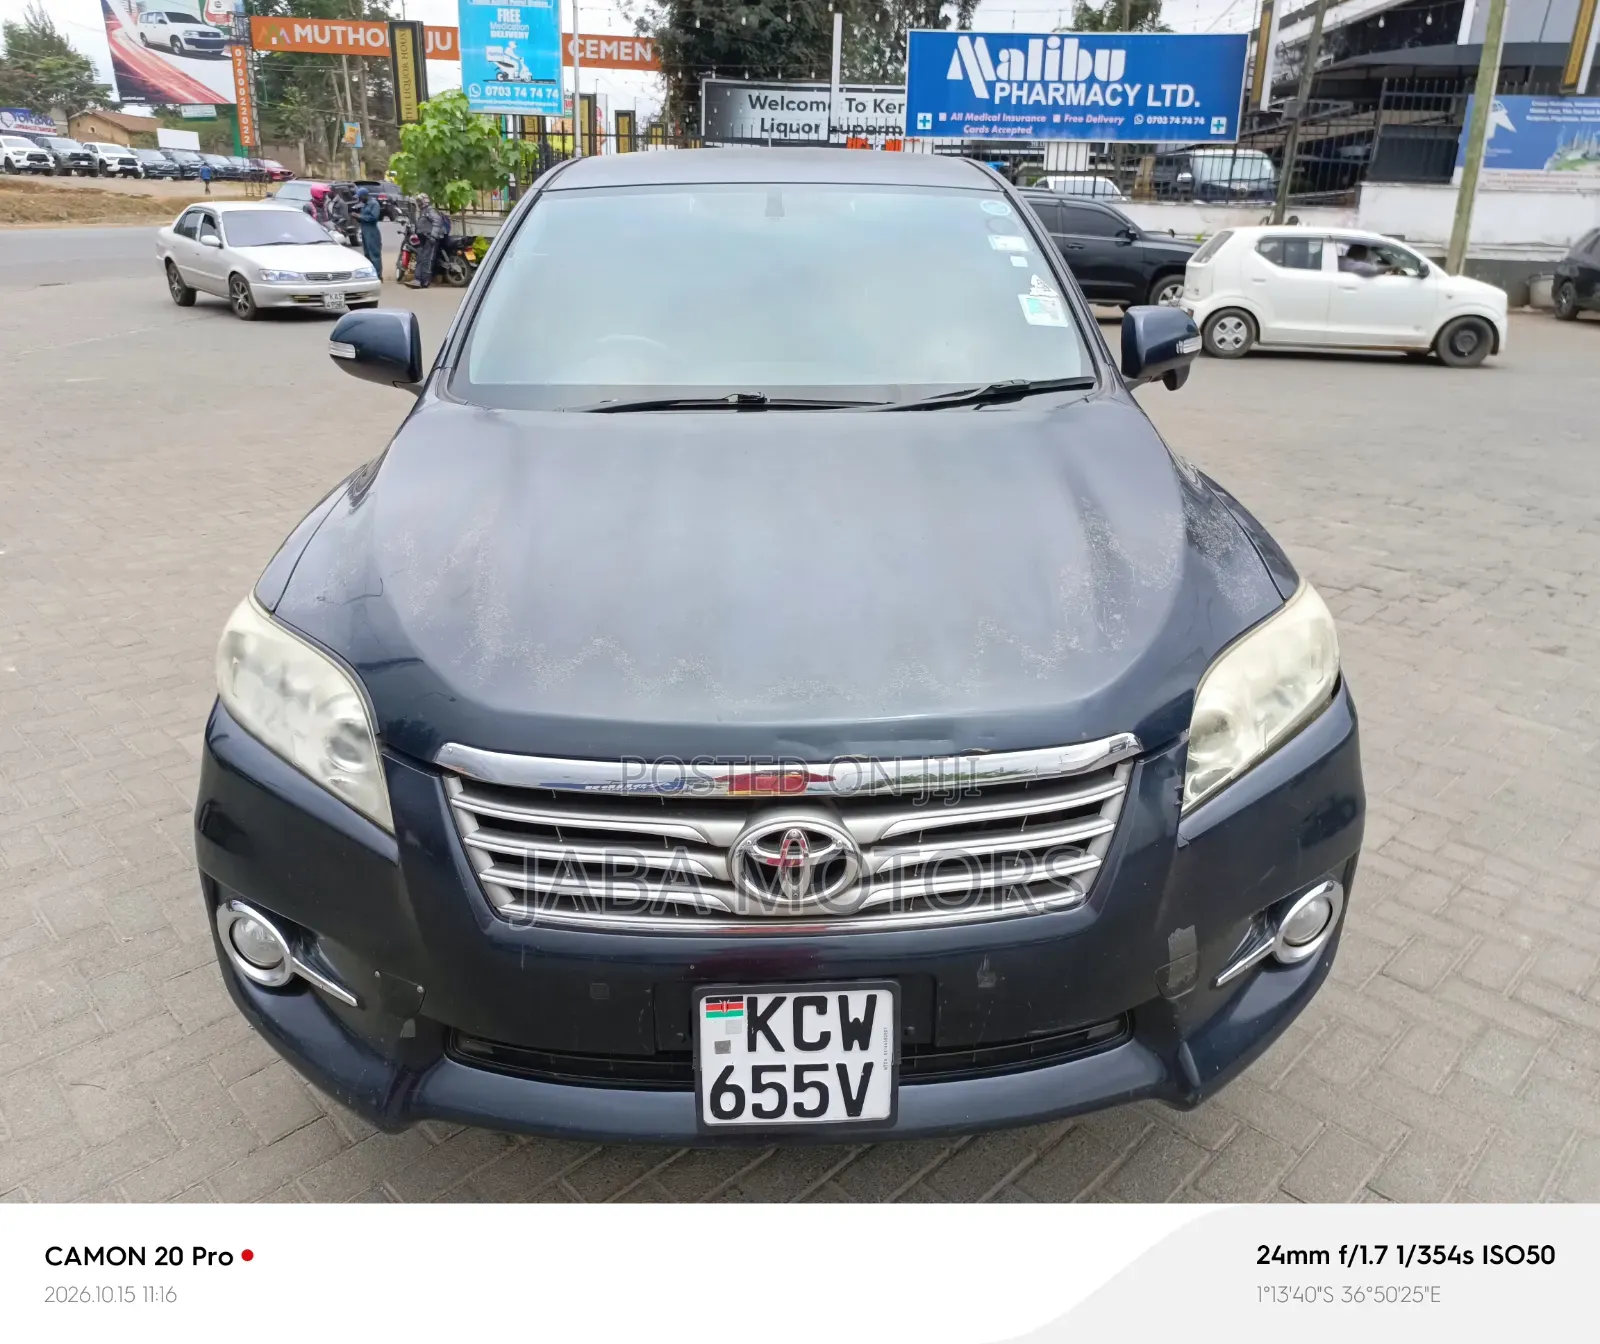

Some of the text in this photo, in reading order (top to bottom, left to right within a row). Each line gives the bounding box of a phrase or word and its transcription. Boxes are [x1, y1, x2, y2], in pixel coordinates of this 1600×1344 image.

[497, 8, 521, 23] FREE
[490, 21, 530, 31] Medication
[490, 30, 530, 40] DELIVERY
[567, 38, 653, 62] CEMEN
[947, 35, 1127, 100] Malibu
[485, 85, 560, 100] 0703 74 74 74
[994, 82, 1201, 108] PHARMACY LTD.
[748, 94, 831, 112] Welcom
[845, 97, 866, 113] To
[950, 112, 1047, 123] All Medical Insurance
[1064, 113, 1125, 126] Free Delivery
[760, 117, 821, 138] Liquor
[963, 124, 1033, 136] Cards Accepted
[747, 994, 877, 1053] KCW
[709, 1062, 874, 1120] 655V
